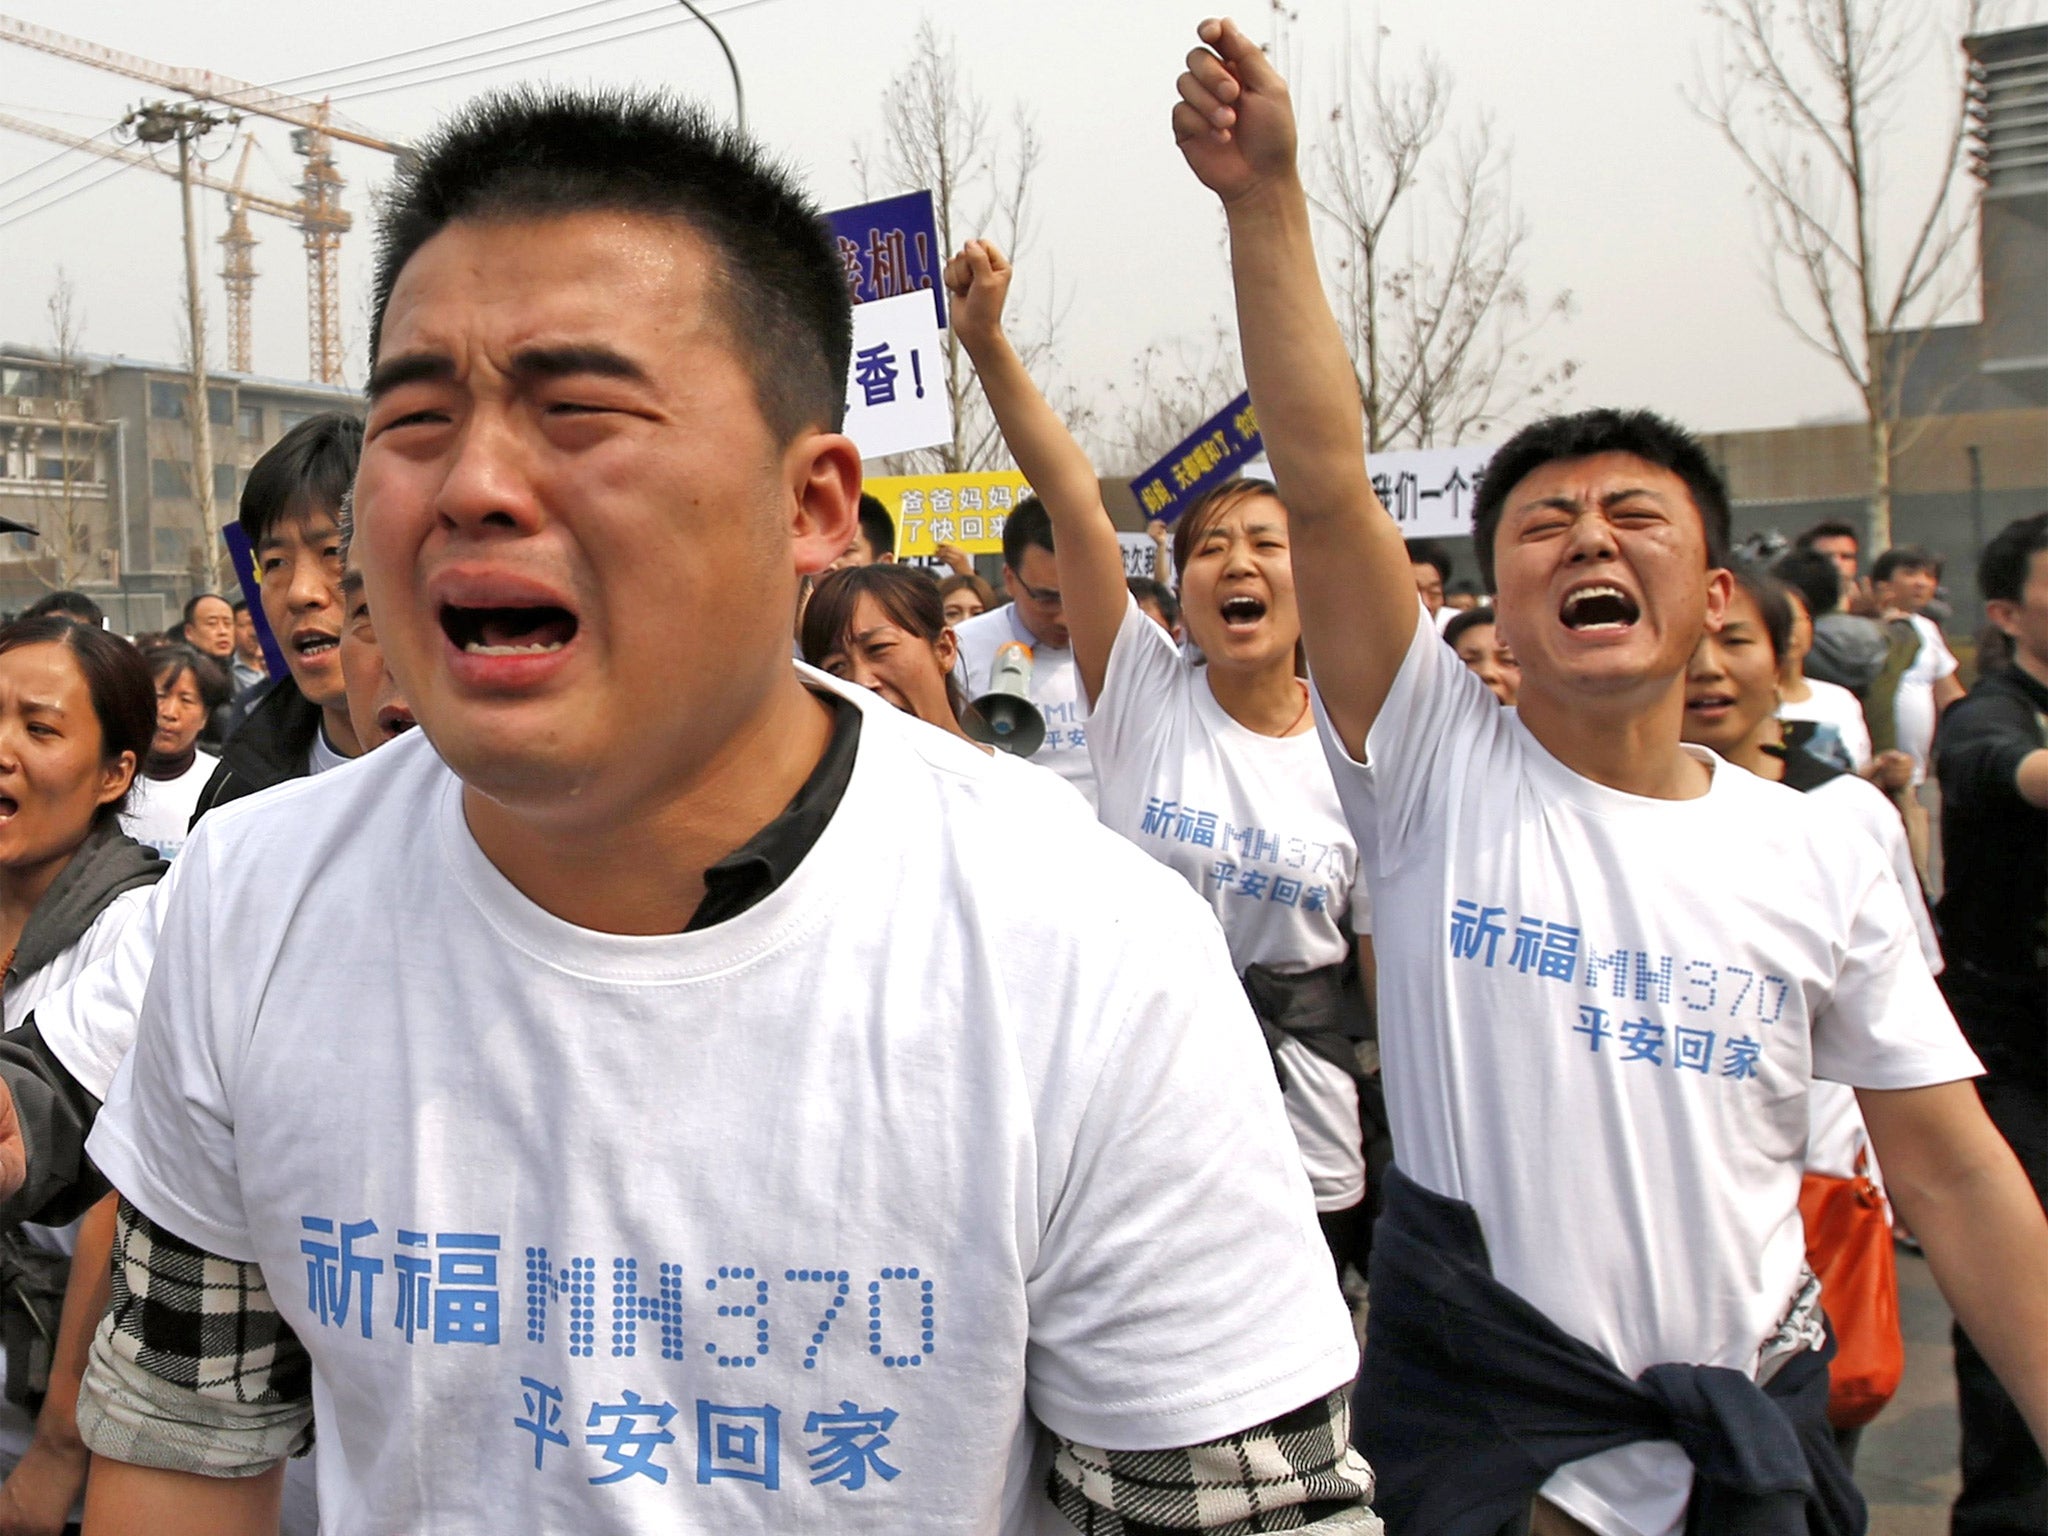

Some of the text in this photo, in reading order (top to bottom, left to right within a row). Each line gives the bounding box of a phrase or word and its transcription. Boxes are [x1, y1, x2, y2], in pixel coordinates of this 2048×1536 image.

[1209, 860, 1328, 912] 平安回家
[1573, 1004, 1762, 1080] 平安回家
[513, 1375, 901, 1491] 平安回家
